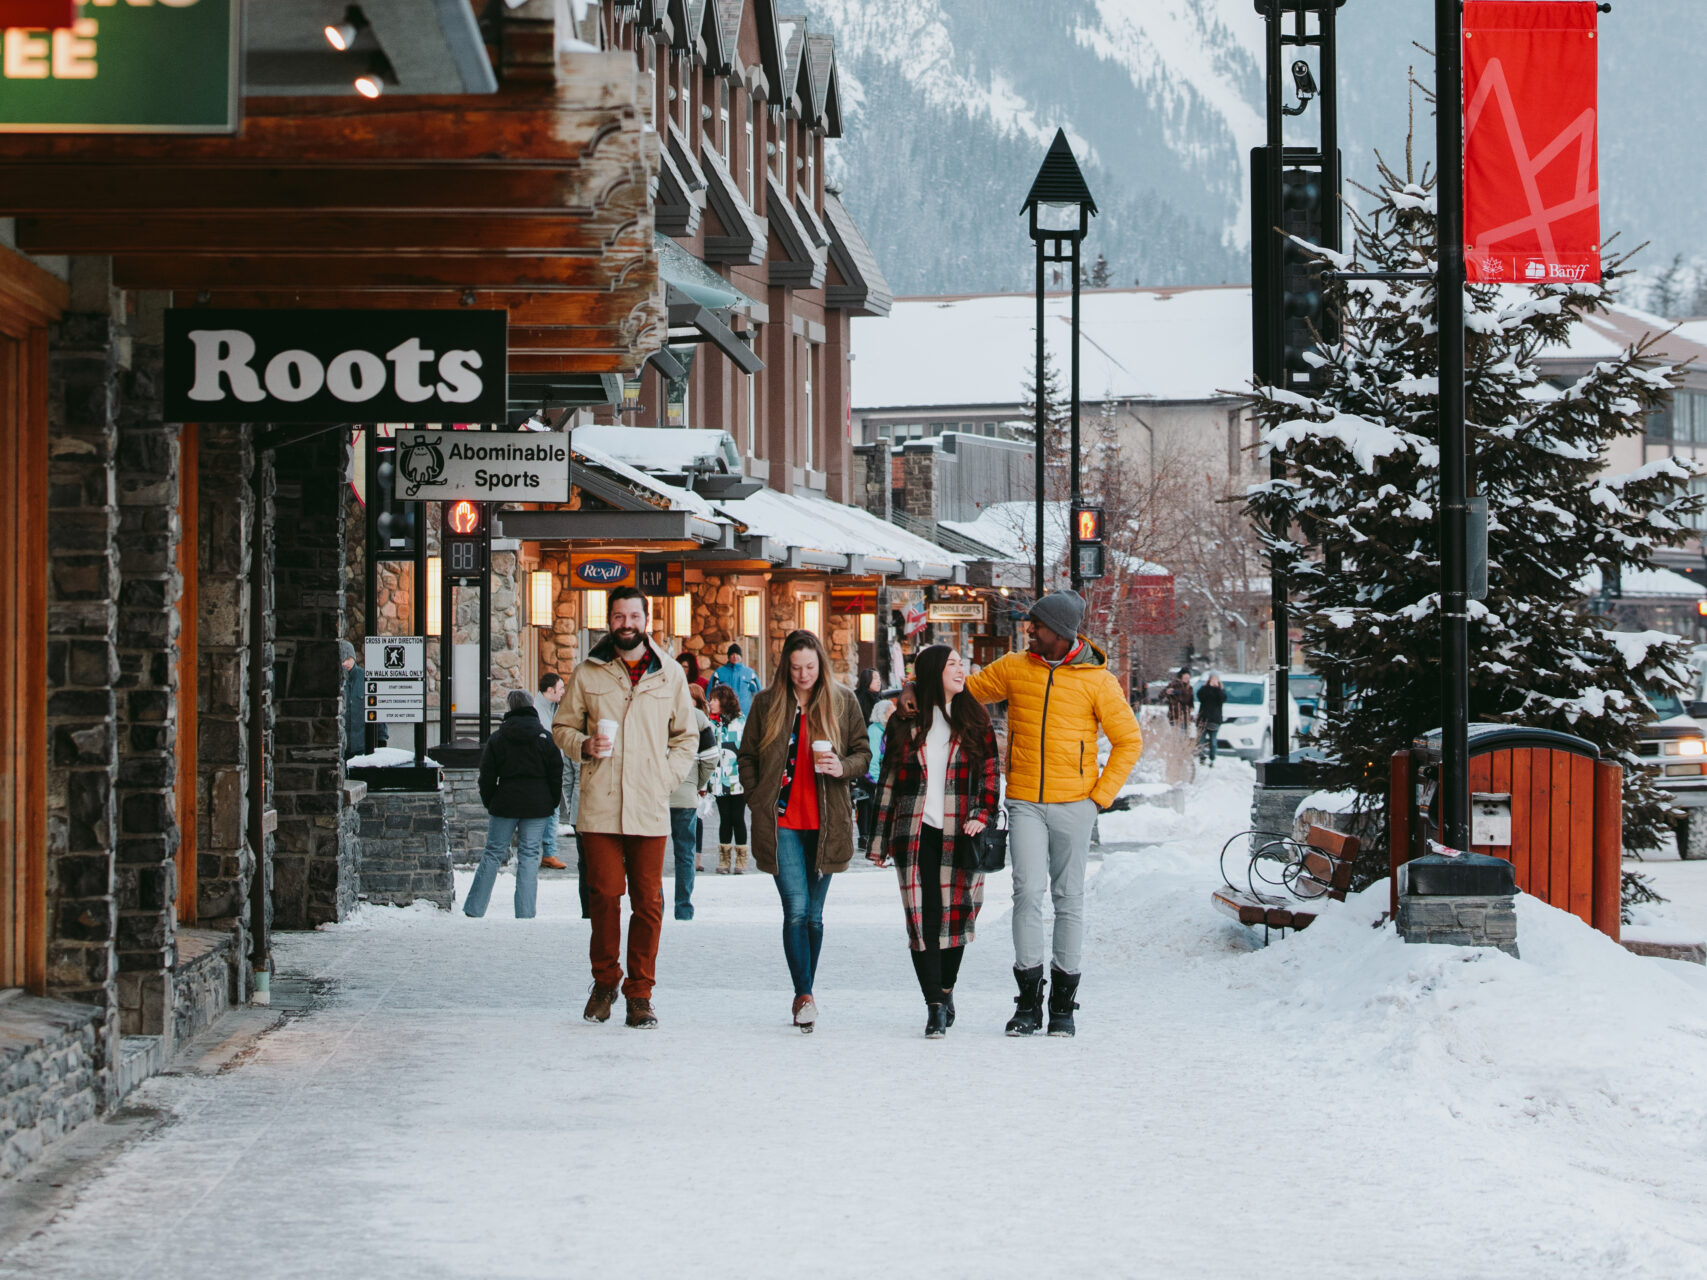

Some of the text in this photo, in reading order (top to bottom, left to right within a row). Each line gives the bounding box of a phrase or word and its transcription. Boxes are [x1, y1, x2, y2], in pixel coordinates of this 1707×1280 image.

[1548, 263, 1589, 280] Banff
[187, 330, 483, 403] Roots
[448, 443, 566, 462] Abominable
[475, 469, 540, 491] Sports
[584, 564, 622, 580] Rexall
[642, 571, 662, 585] GAP
[932, 605, 981, 615] RUNDLE GIFTS
